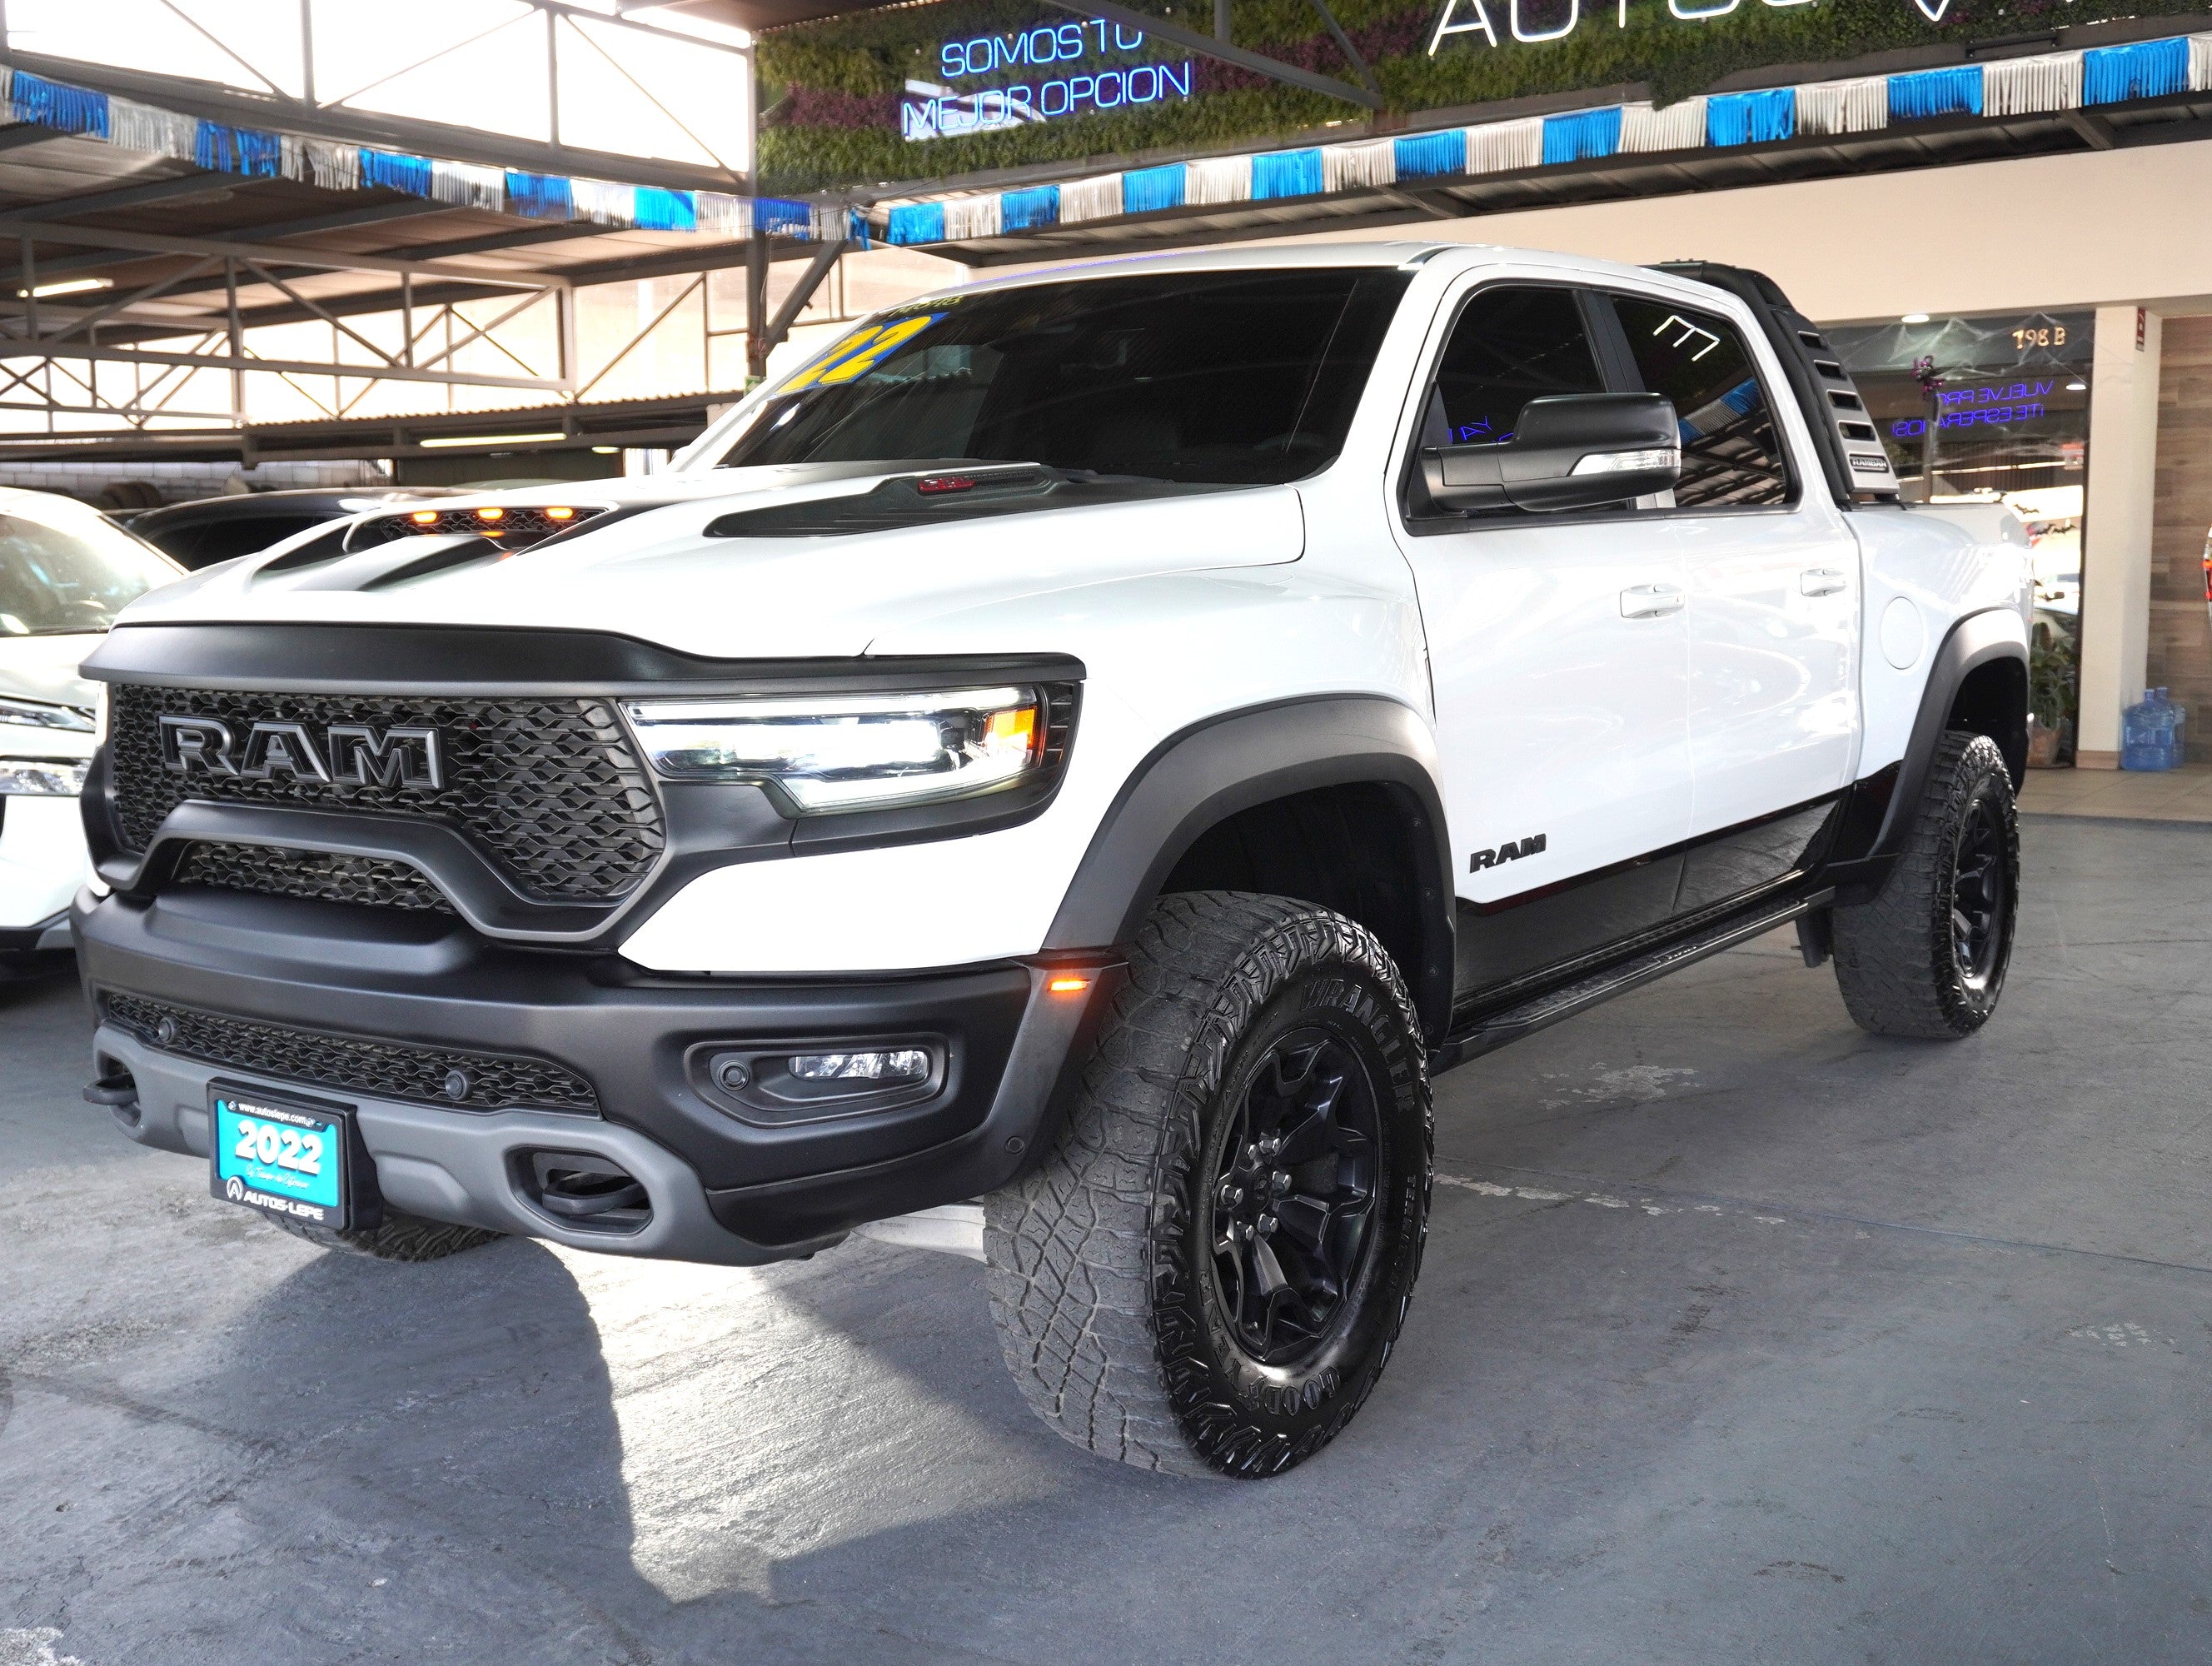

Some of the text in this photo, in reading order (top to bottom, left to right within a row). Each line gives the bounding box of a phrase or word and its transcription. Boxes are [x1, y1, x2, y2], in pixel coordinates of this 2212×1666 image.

[941, 18, 1143, 78] SOMOS TU
[903, 62, 1190, 135] MEJOR OPCION
[1852, 458, 1887, 467] RAMBAR
[158, 715, 445, 791] RAM
[1469, 833, 1547, 874] RAM
[234, 1119, 323, 1176] 2022
[1199, 1271, 1341, 1416] GOODYEAR
